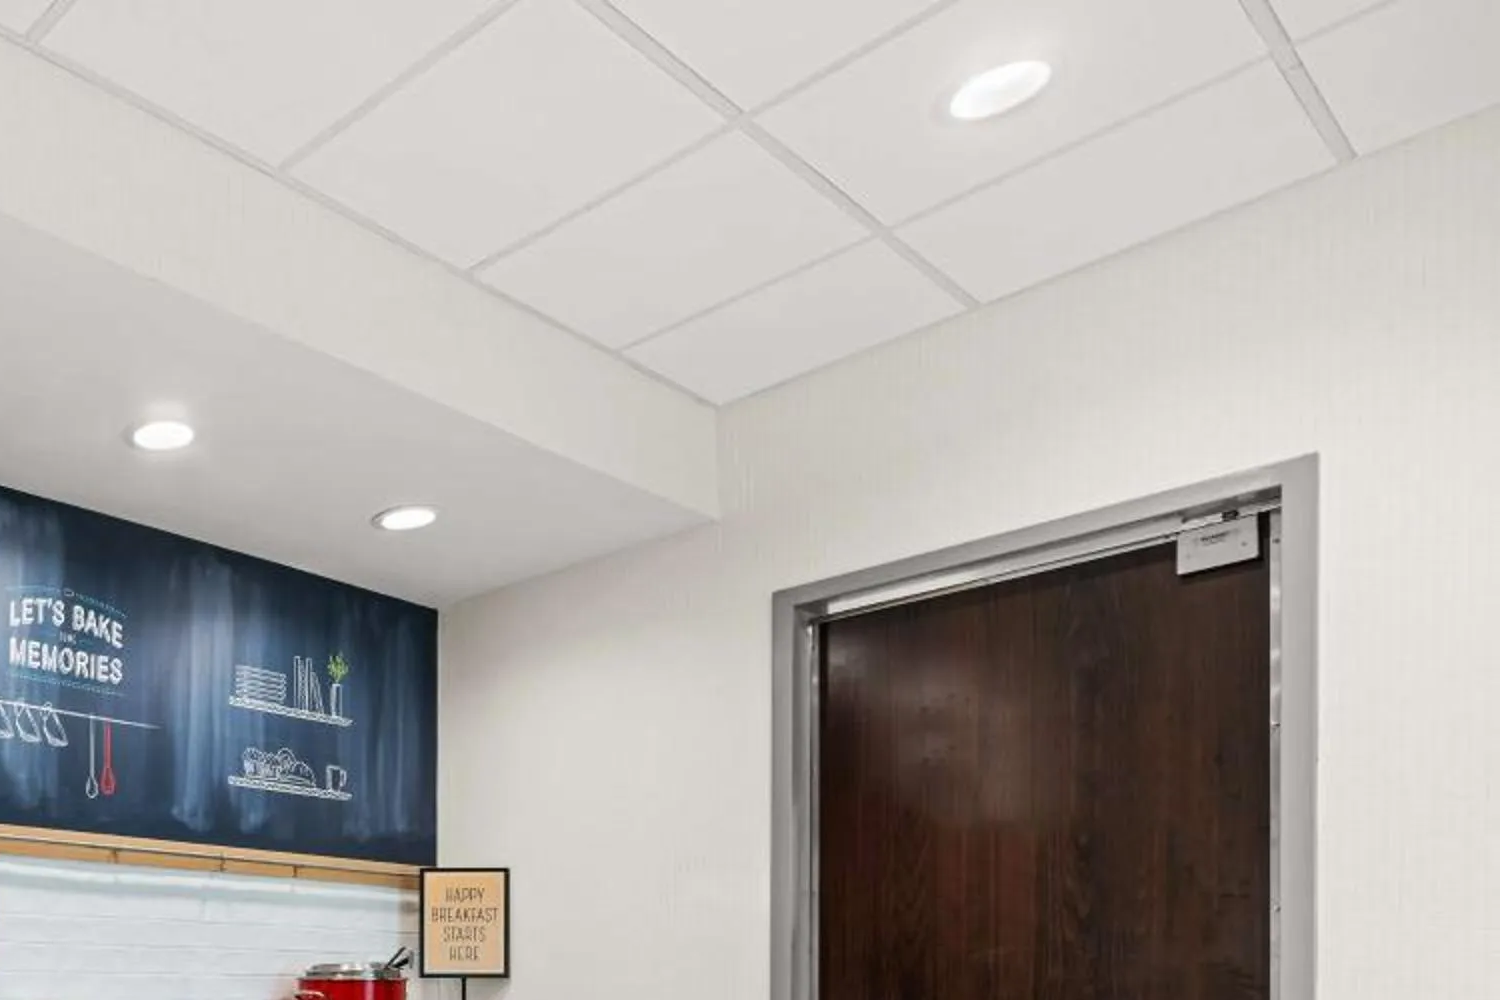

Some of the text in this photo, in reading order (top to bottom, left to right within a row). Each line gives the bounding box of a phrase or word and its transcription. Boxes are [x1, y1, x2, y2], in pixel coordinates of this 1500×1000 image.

[9, 597, 124, 649] LET'S BAKE
[9, 637, 124, 685] MEMORIES
[445, 887, 485, 902] HAPPY
[431, 907, 499, 923] BREAKFAST
[443, 926, 487, 942] STARTS
[449, 946, 480, 961] HERE
